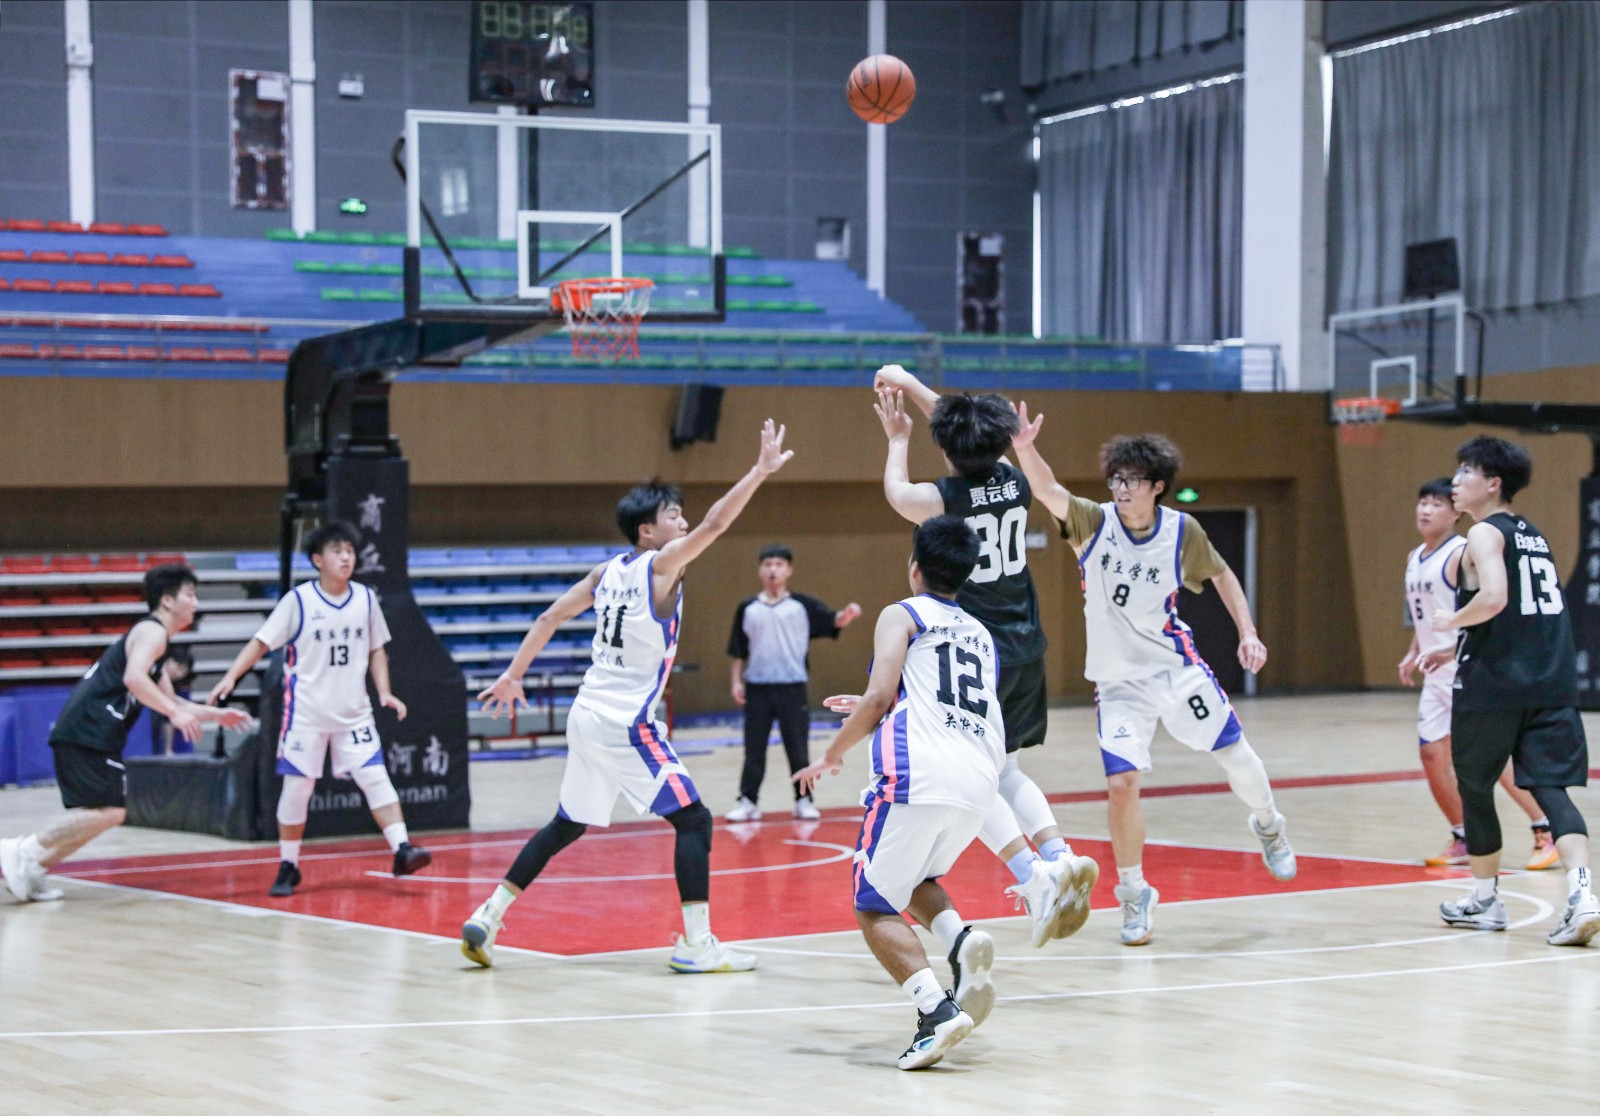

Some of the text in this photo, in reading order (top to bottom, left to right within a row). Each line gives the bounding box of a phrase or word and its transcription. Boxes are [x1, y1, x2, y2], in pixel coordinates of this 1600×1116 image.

[969, 480, 1020, 508] 贾云菲
[964, 505, 1028, 583] 30
[1112, 583, 1130, 607] 8
[1518, 554, 1564, 615] 13
[602, 604, 628, 649] 11
[329, 645, 350, 667] 13
[935, 641, 989, 719] 12
[1188, 695, 1210, 720] 8
[351, 726, 373, 744] 13
[387, 735, 450, 777] 河南
[308, 783, 449, 812] hina nan
